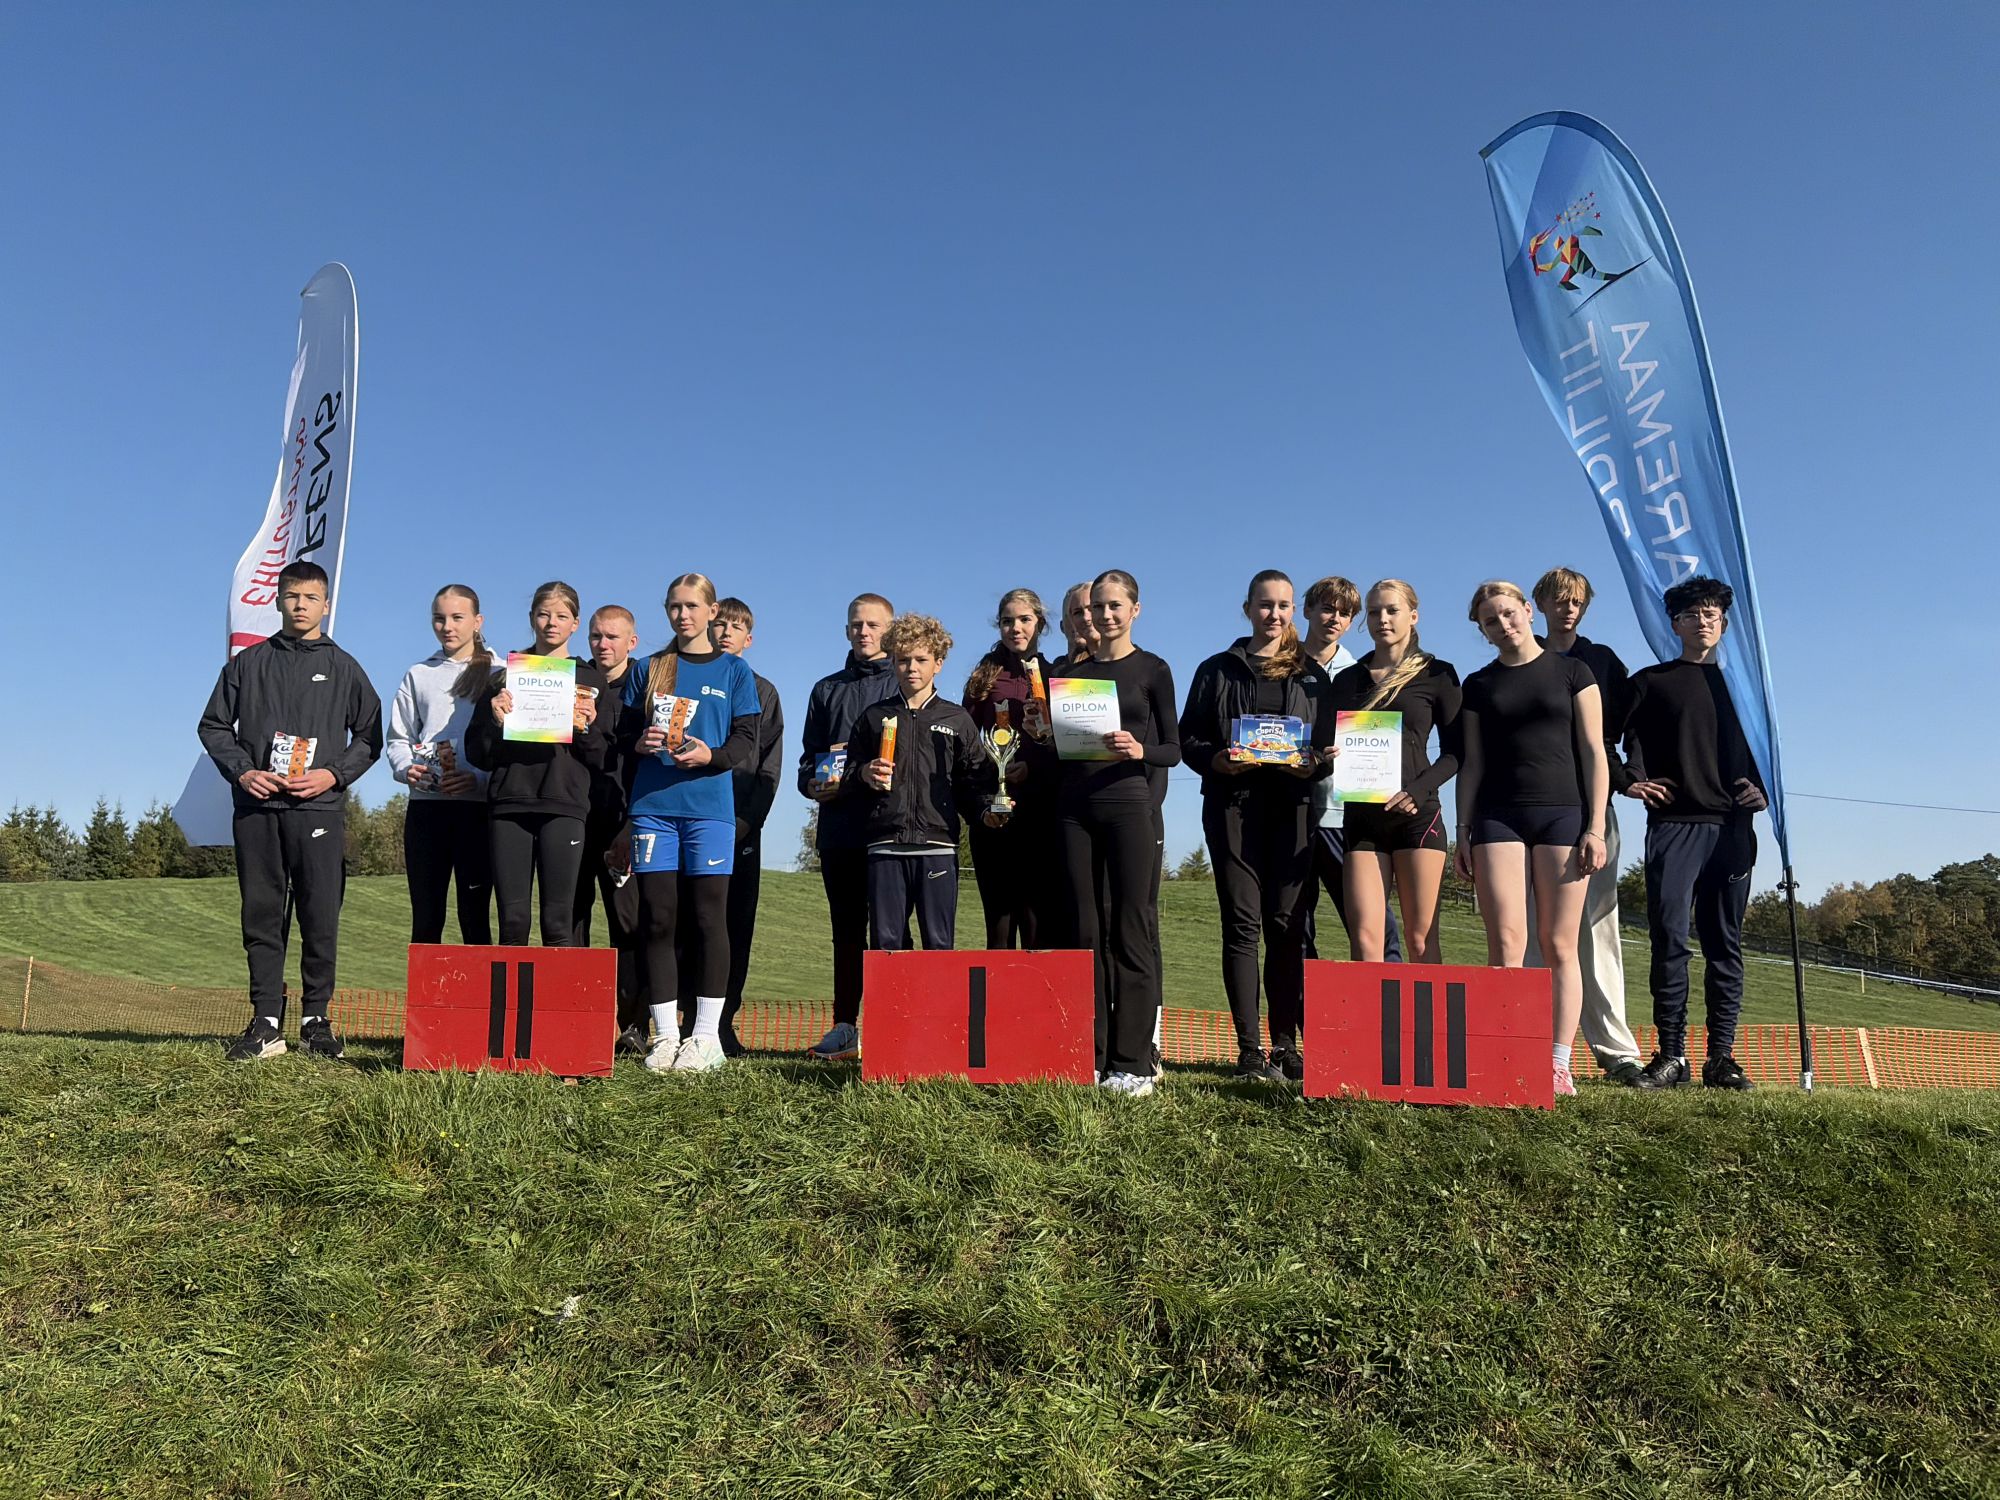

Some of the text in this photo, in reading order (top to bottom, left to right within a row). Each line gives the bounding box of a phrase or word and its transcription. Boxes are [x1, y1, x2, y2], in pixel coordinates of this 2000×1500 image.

[518, 677, 563, 688] DIPLOM
[1062, 703, 1107, 713] DIPLOM
[1345, 737, 1390, 747] DIPLOM
[488, 961, 534, 1060] II
[968, 966, 987, 1068] I
[1381, 979, 1467, 1089] III
